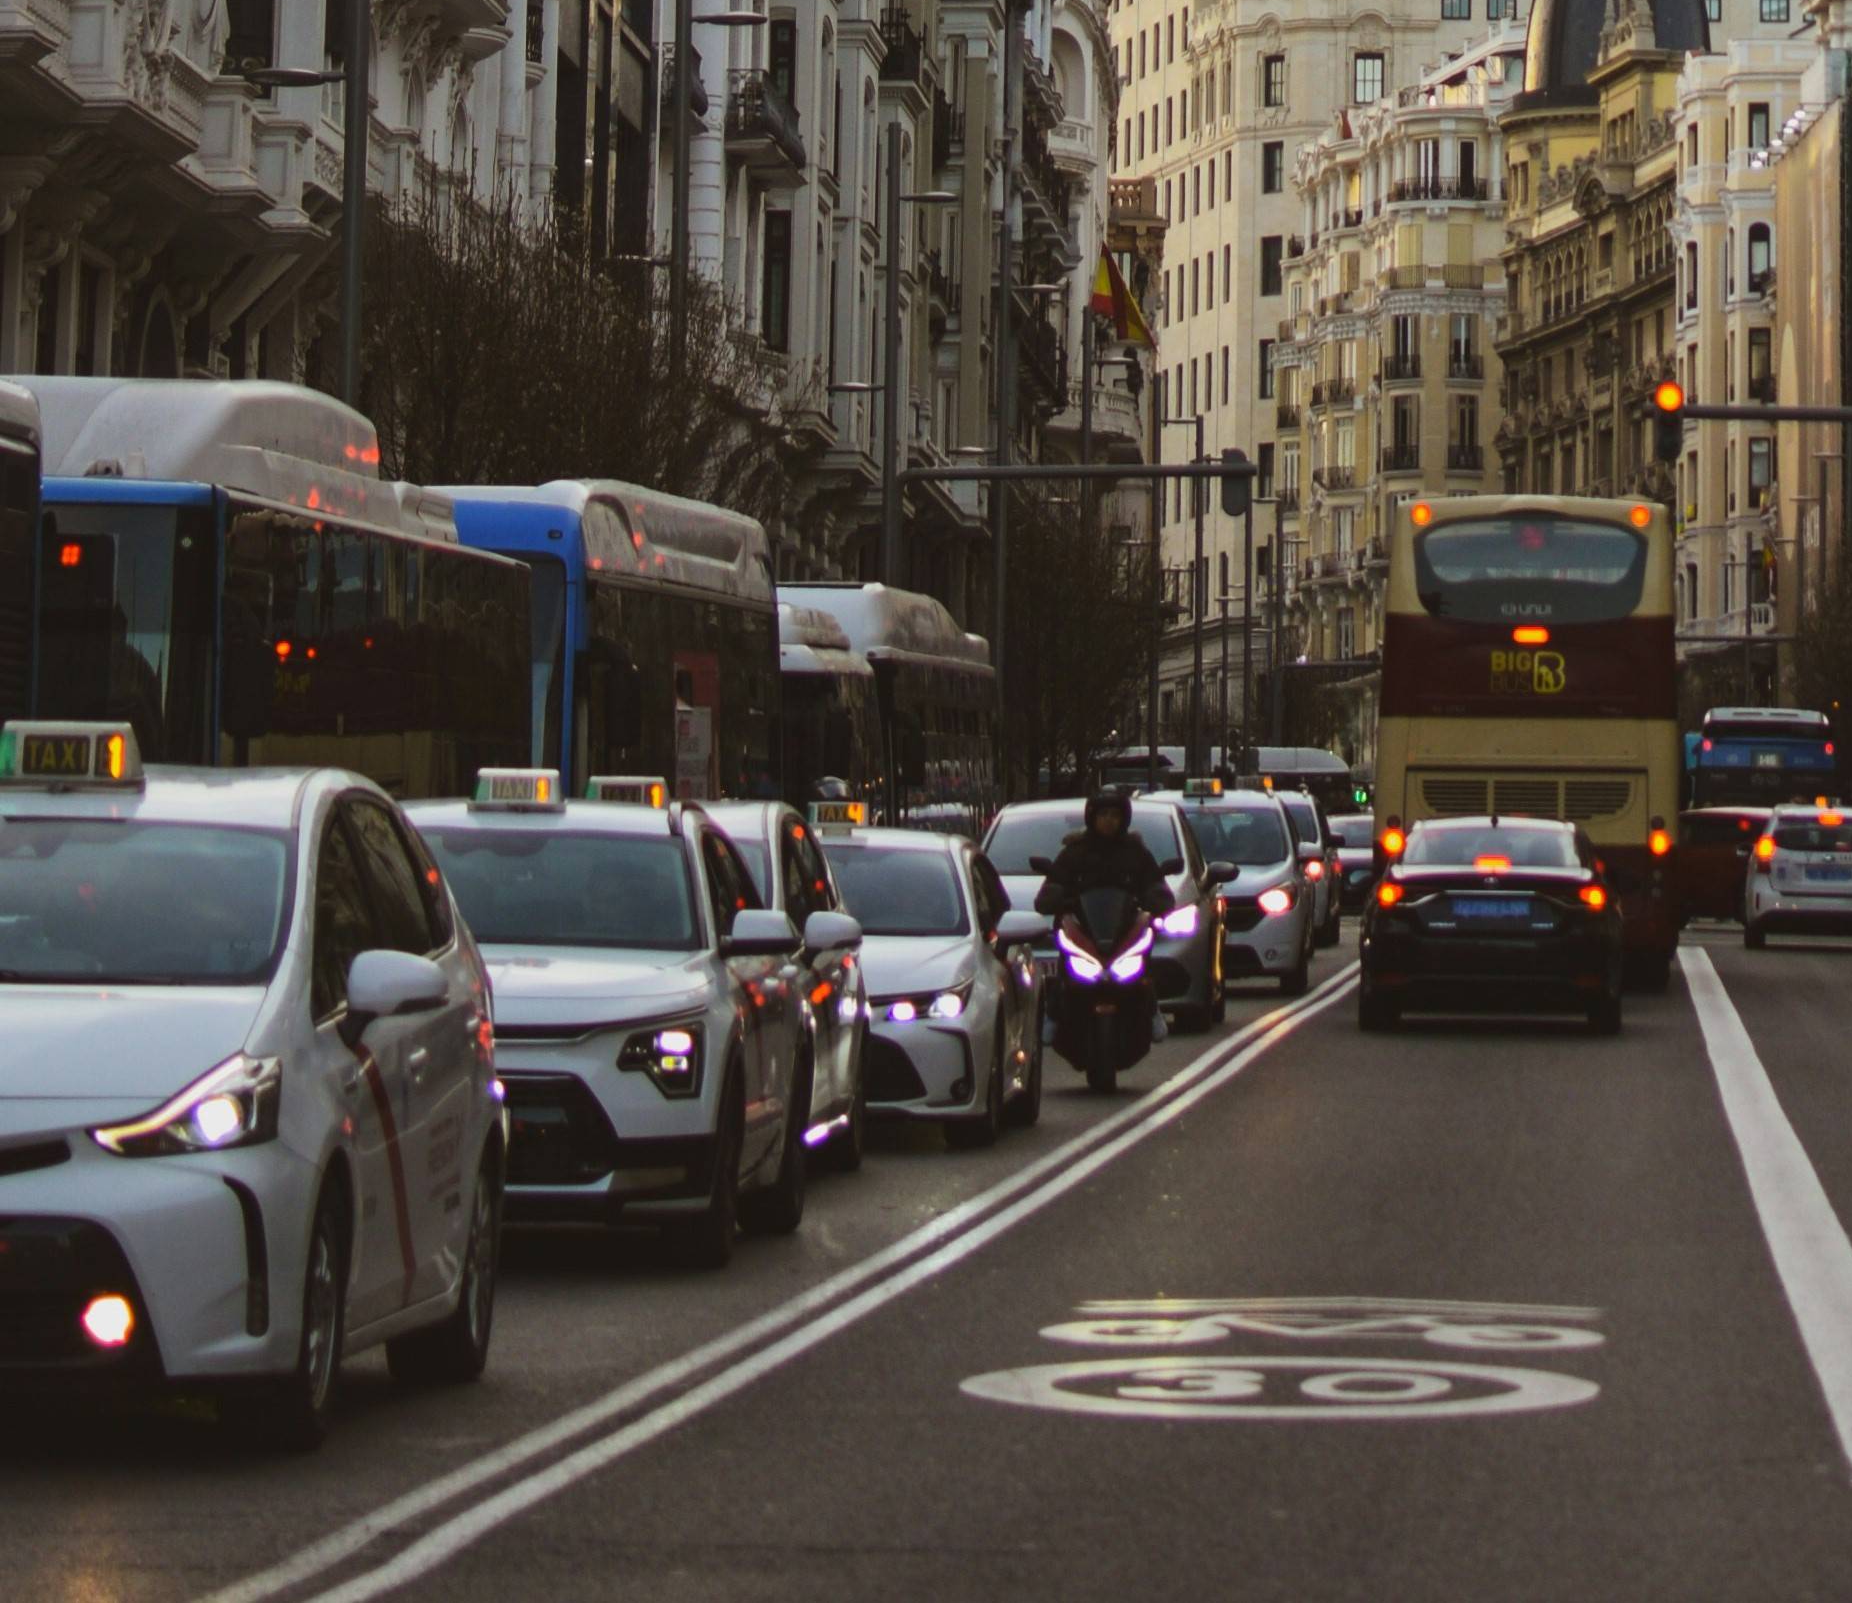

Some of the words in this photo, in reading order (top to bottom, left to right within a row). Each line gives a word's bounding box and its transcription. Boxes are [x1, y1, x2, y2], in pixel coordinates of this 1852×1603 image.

[1490, 651, 1531, 672] BIG
[1490, 674, 1531, 694] BUS
[29, 740, 87, 769] TAXI
[495, 778, 532, 798] TAXI
[1116, 1367, 1452, 1402] 30
